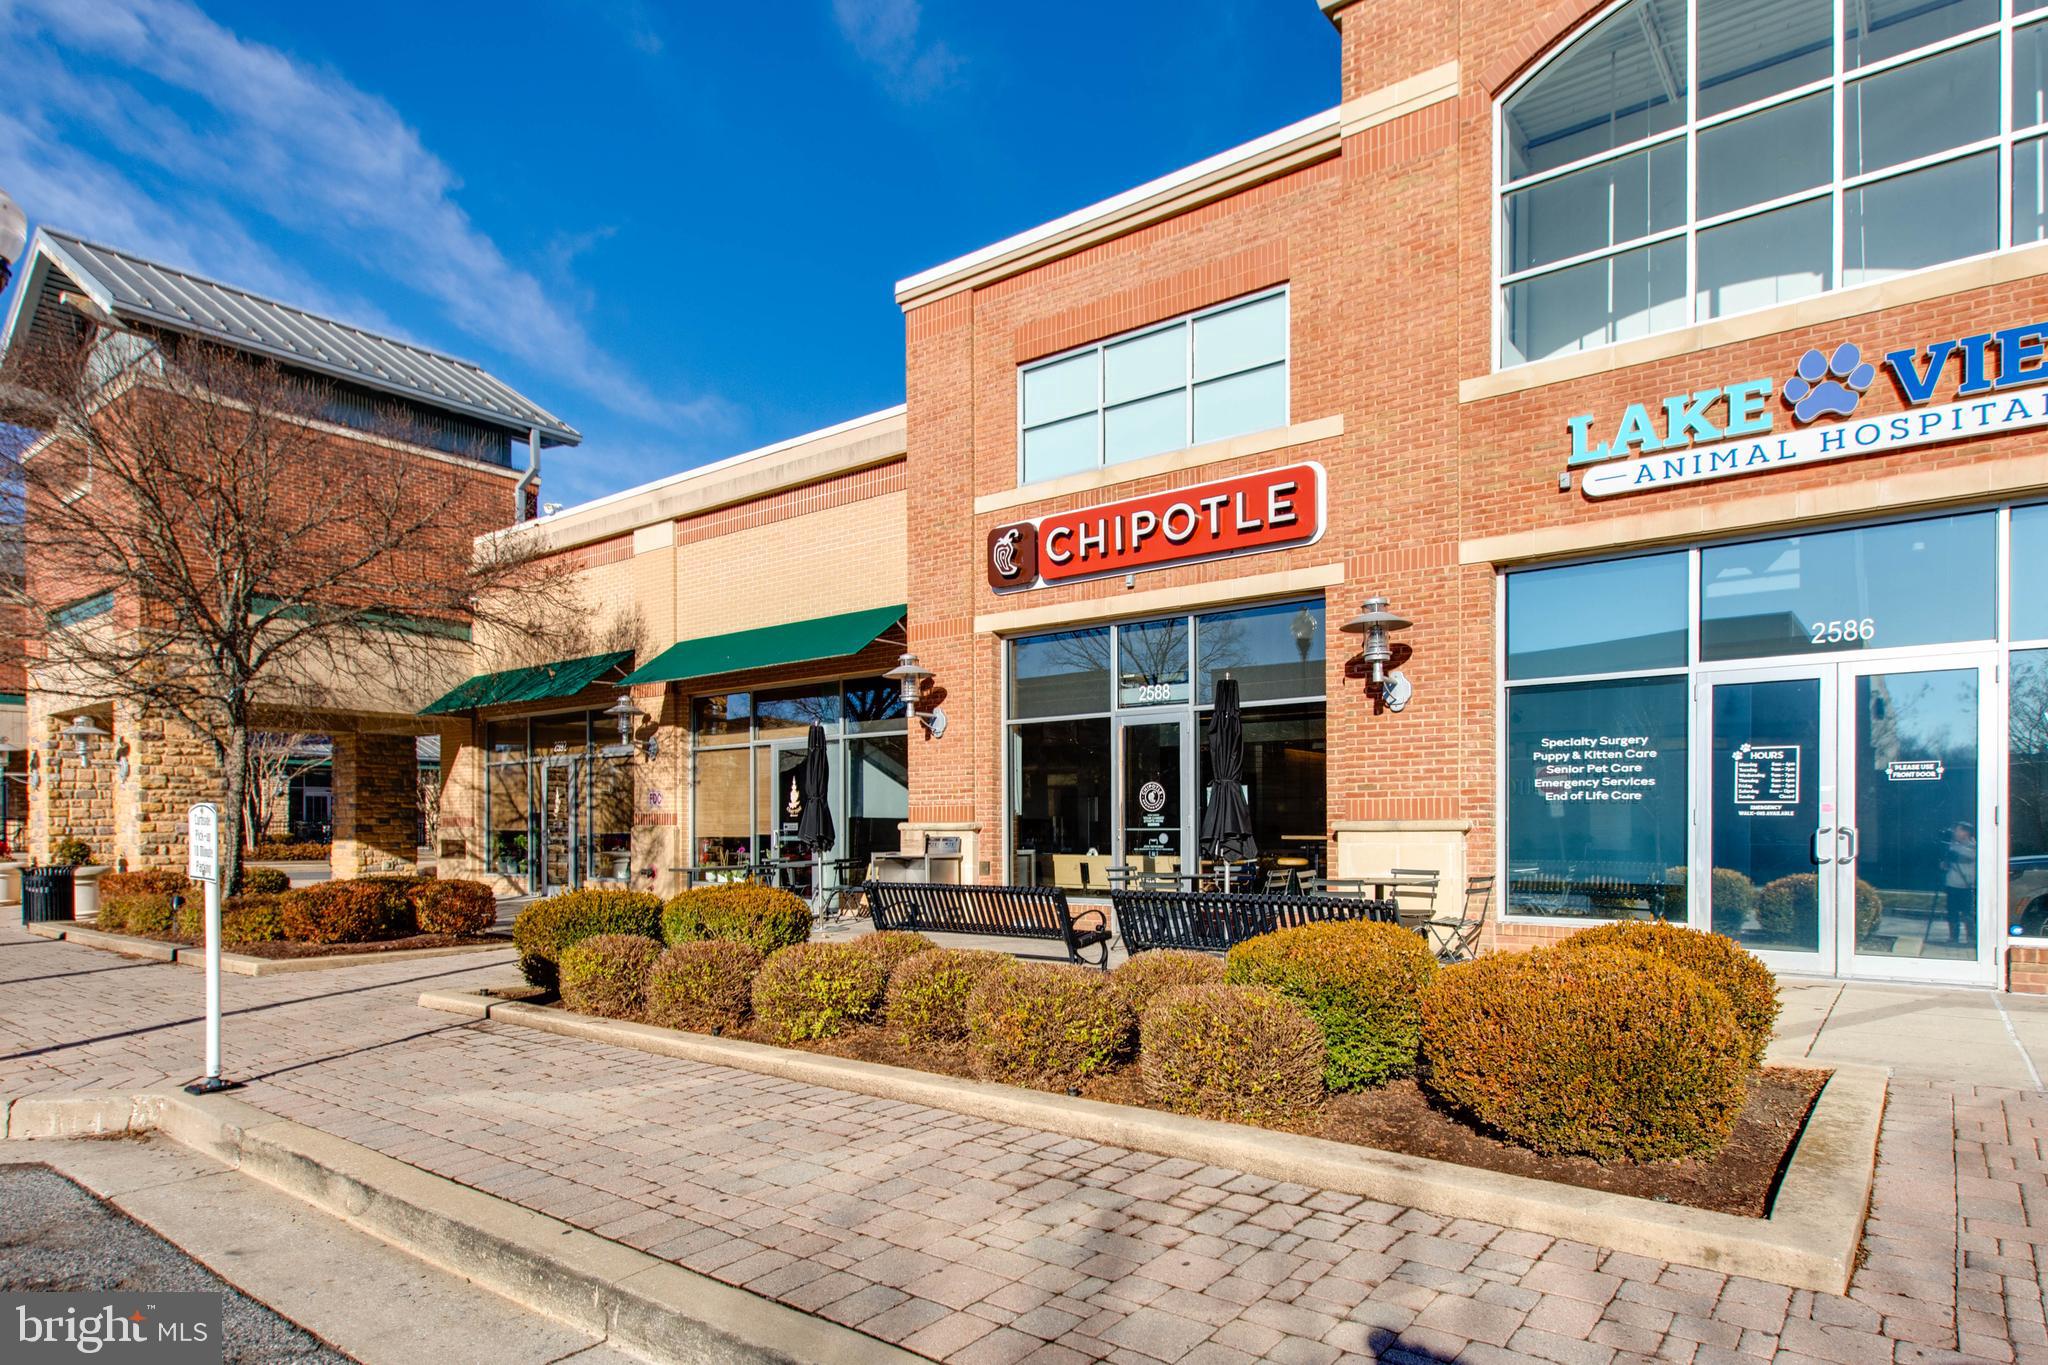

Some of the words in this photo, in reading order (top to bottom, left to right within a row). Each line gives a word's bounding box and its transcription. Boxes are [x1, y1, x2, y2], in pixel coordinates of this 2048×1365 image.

[1568, 377, 1773, 465] LAKE
[1634, 439, 1797, 485] ANIMAL
[1045, 482, 1298, 564] CHIPOTLE
[1811, 618, 1875, 644] 2586
[1139, 683, 1170, 702] 2588
[1541, 736, 1598, 749] Specialty
[1599, 736, 1648, 747] Surgery
[1533, 751, 1571, 762] Puppy
[1572, 751, 1582, 760] &
[1584, 750, 1623, 760] Kitten
[1625, 749, 1658, 759] Care
[1750, 751, 1784, 760] HOURS
[1546, 765, 1584, 774] Senior
[1586, 764, 1609, 773] Pet
[1610, 763, 1643, 772] Care
[1534, 778, 1600, 789] Emergency
[1601, 777, 1656, 787] Services
[1141, 784, 1163, 796] CHIPOTLE
[1545, 792, 1568, 801] End
[1569, 791, 1584, 800] of
[1585, 791, 1609, 800] Life
[1611, 791, 1642, 800] Care
[650, 792, 662, 804] FDC
